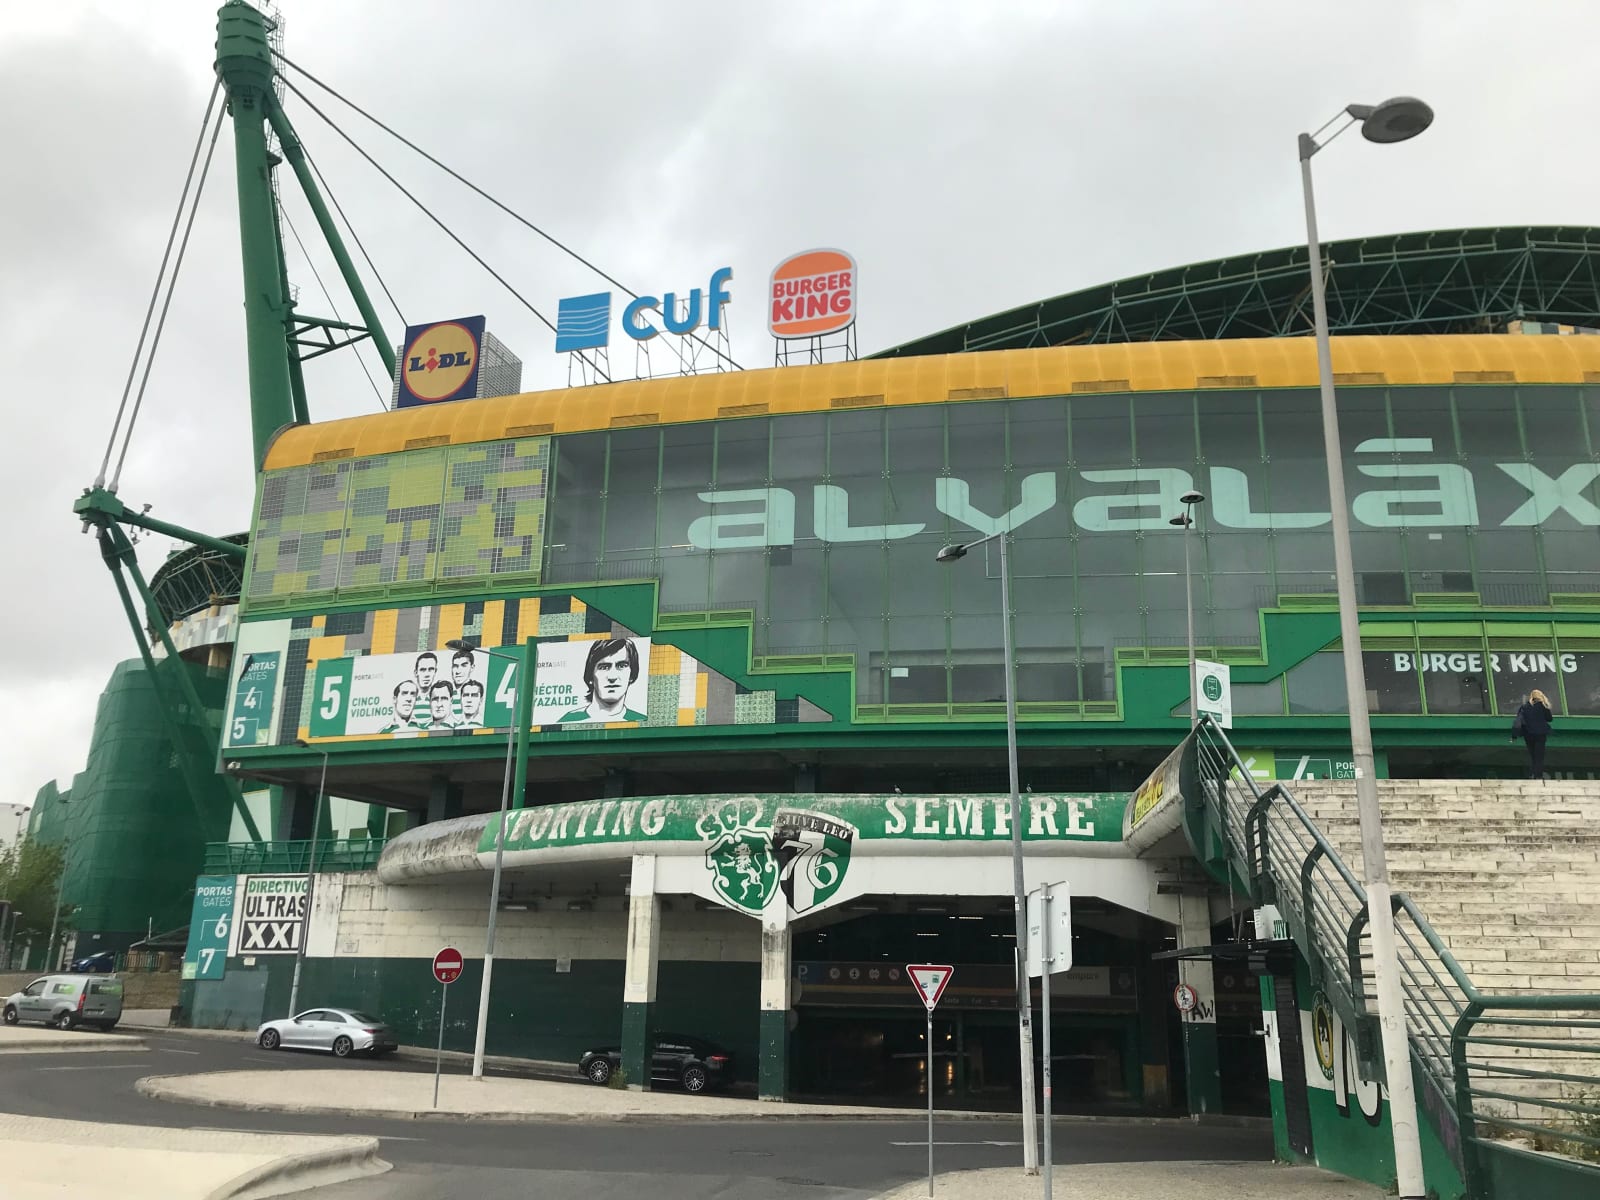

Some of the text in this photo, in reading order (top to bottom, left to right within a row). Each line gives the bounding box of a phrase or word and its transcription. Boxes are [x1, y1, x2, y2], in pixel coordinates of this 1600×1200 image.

[773, 272, 852, 299] BURGER
[622, 267, 732, 341] cuf
[772, 289, 851, 323] KING
[248, 661, 277, 672] ORTAS
[1394, 653, 1578, 673] BURGER KING
[494, 662, 519, 709] 4
[243, 686, 257, 709] 4
[320, 675, 343, 720] 5
[352, 696, 380, 706] CINCO
[351, 707, 394, 717] VIOLINOS
[232, 716, 247, 739] 5
[1336, 762, 1354, 770] POR
[1337, 770, 1354, 779] GAT
[494, 800, 666, 843] SPORTING
[696, 798, 763, 839] SCP
[885, 797, 1095, 836] SEMPRE
[822, 822, 848, 840] LEO
[780, 839, 839, 889] 76
[197, 886, 233, 896] PORTAS
[248, 881, 310, 893] DIRECTIVO
[202, 896, 231, 907] GATES
[246, 895, 306, 917] ULTRAS
[215, 913, 228, 938] 6
[244, 922, 303, 949] XXI
[201, 948, 216, 974] 7
